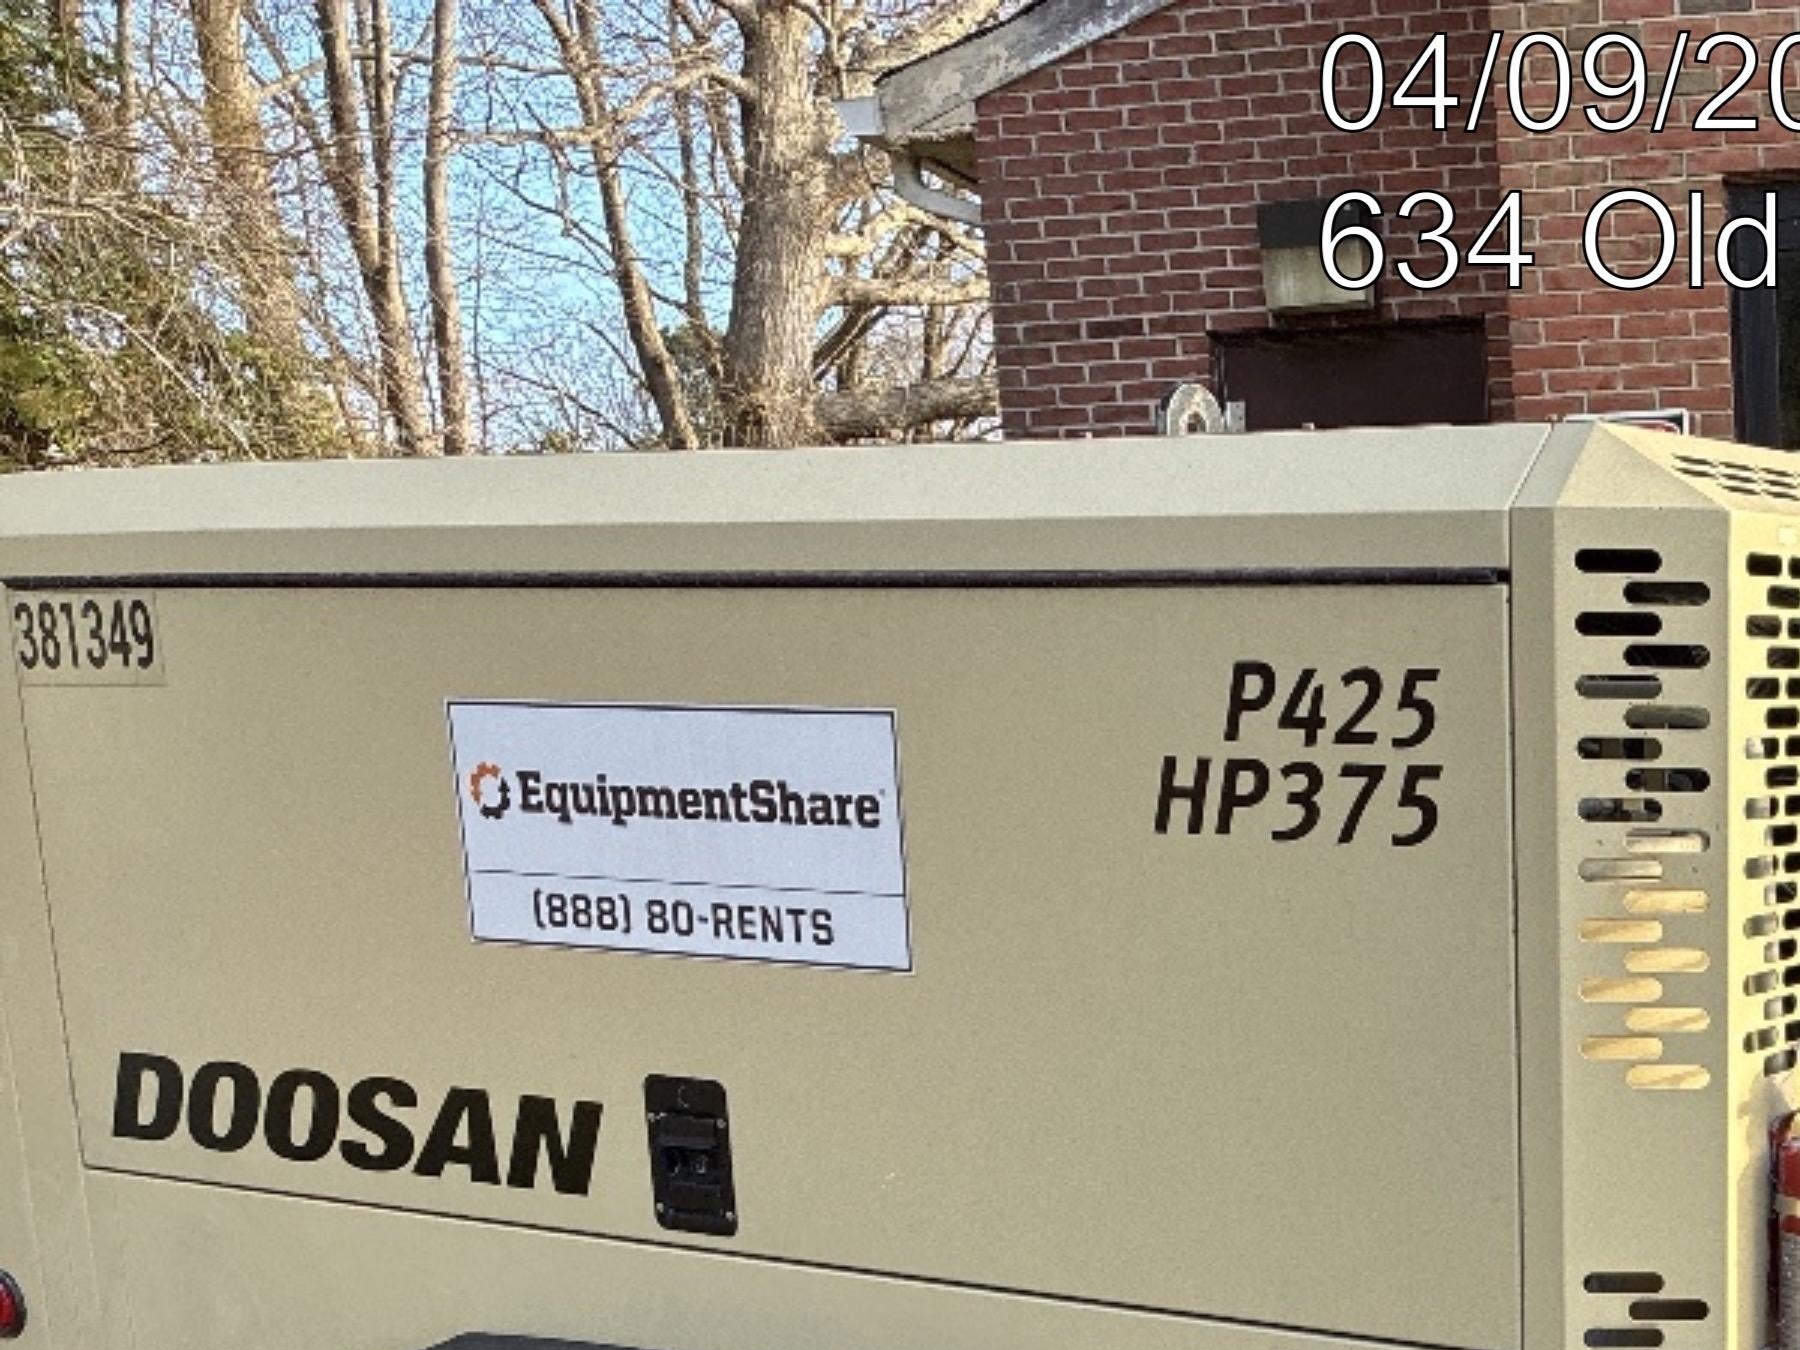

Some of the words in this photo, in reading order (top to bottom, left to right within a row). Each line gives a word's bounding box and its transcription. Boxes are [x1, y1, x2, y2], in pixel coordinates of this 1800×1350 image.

[14, 599, 154, 670] 381349
[1223, 659, 1441, 748] P425
[516, 769, 882, 829] EquipmentShare
[1154, 755, 1444, 847] HP375
[532, 887, 632, 934] (888)
[646, 898, 835, 946] 80-RENTS
[111, 1050, 604, 1197] DOOSAN
